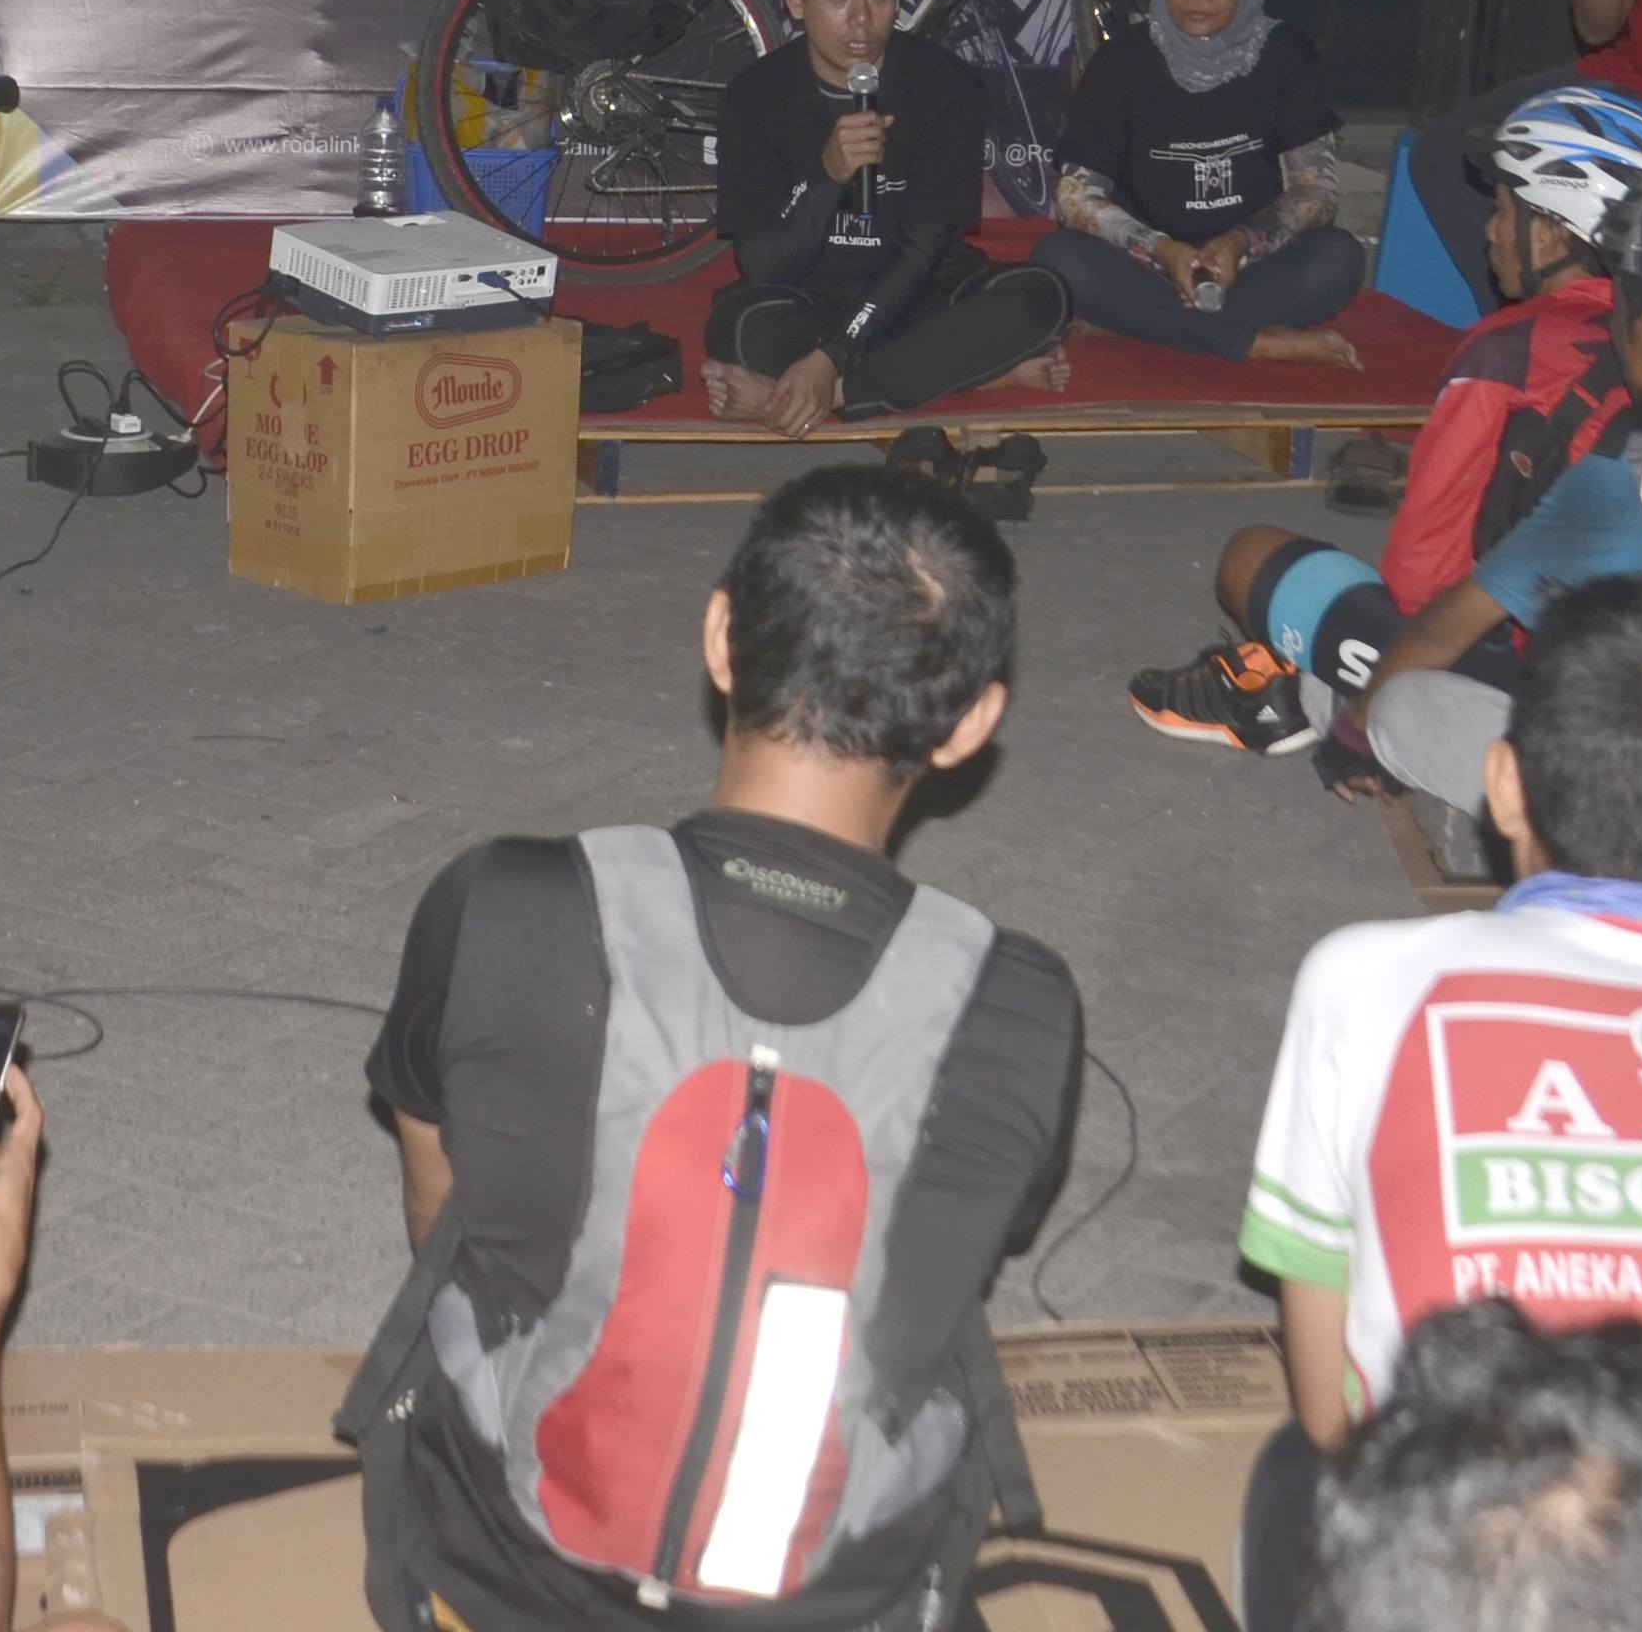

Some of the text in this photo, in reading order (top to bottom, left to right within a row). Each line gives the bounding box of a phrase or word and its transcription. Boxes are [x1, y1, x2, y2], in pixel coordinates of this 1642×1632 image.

[1185, 194, 1243, 210] POLYGON
[431, 371, 505, 410] Monde
[245, 436, 279, 463] EGG
[407, 428, 530, 469] EGG DROP
[1513, 1250, 1641, 1306] ANEKA
